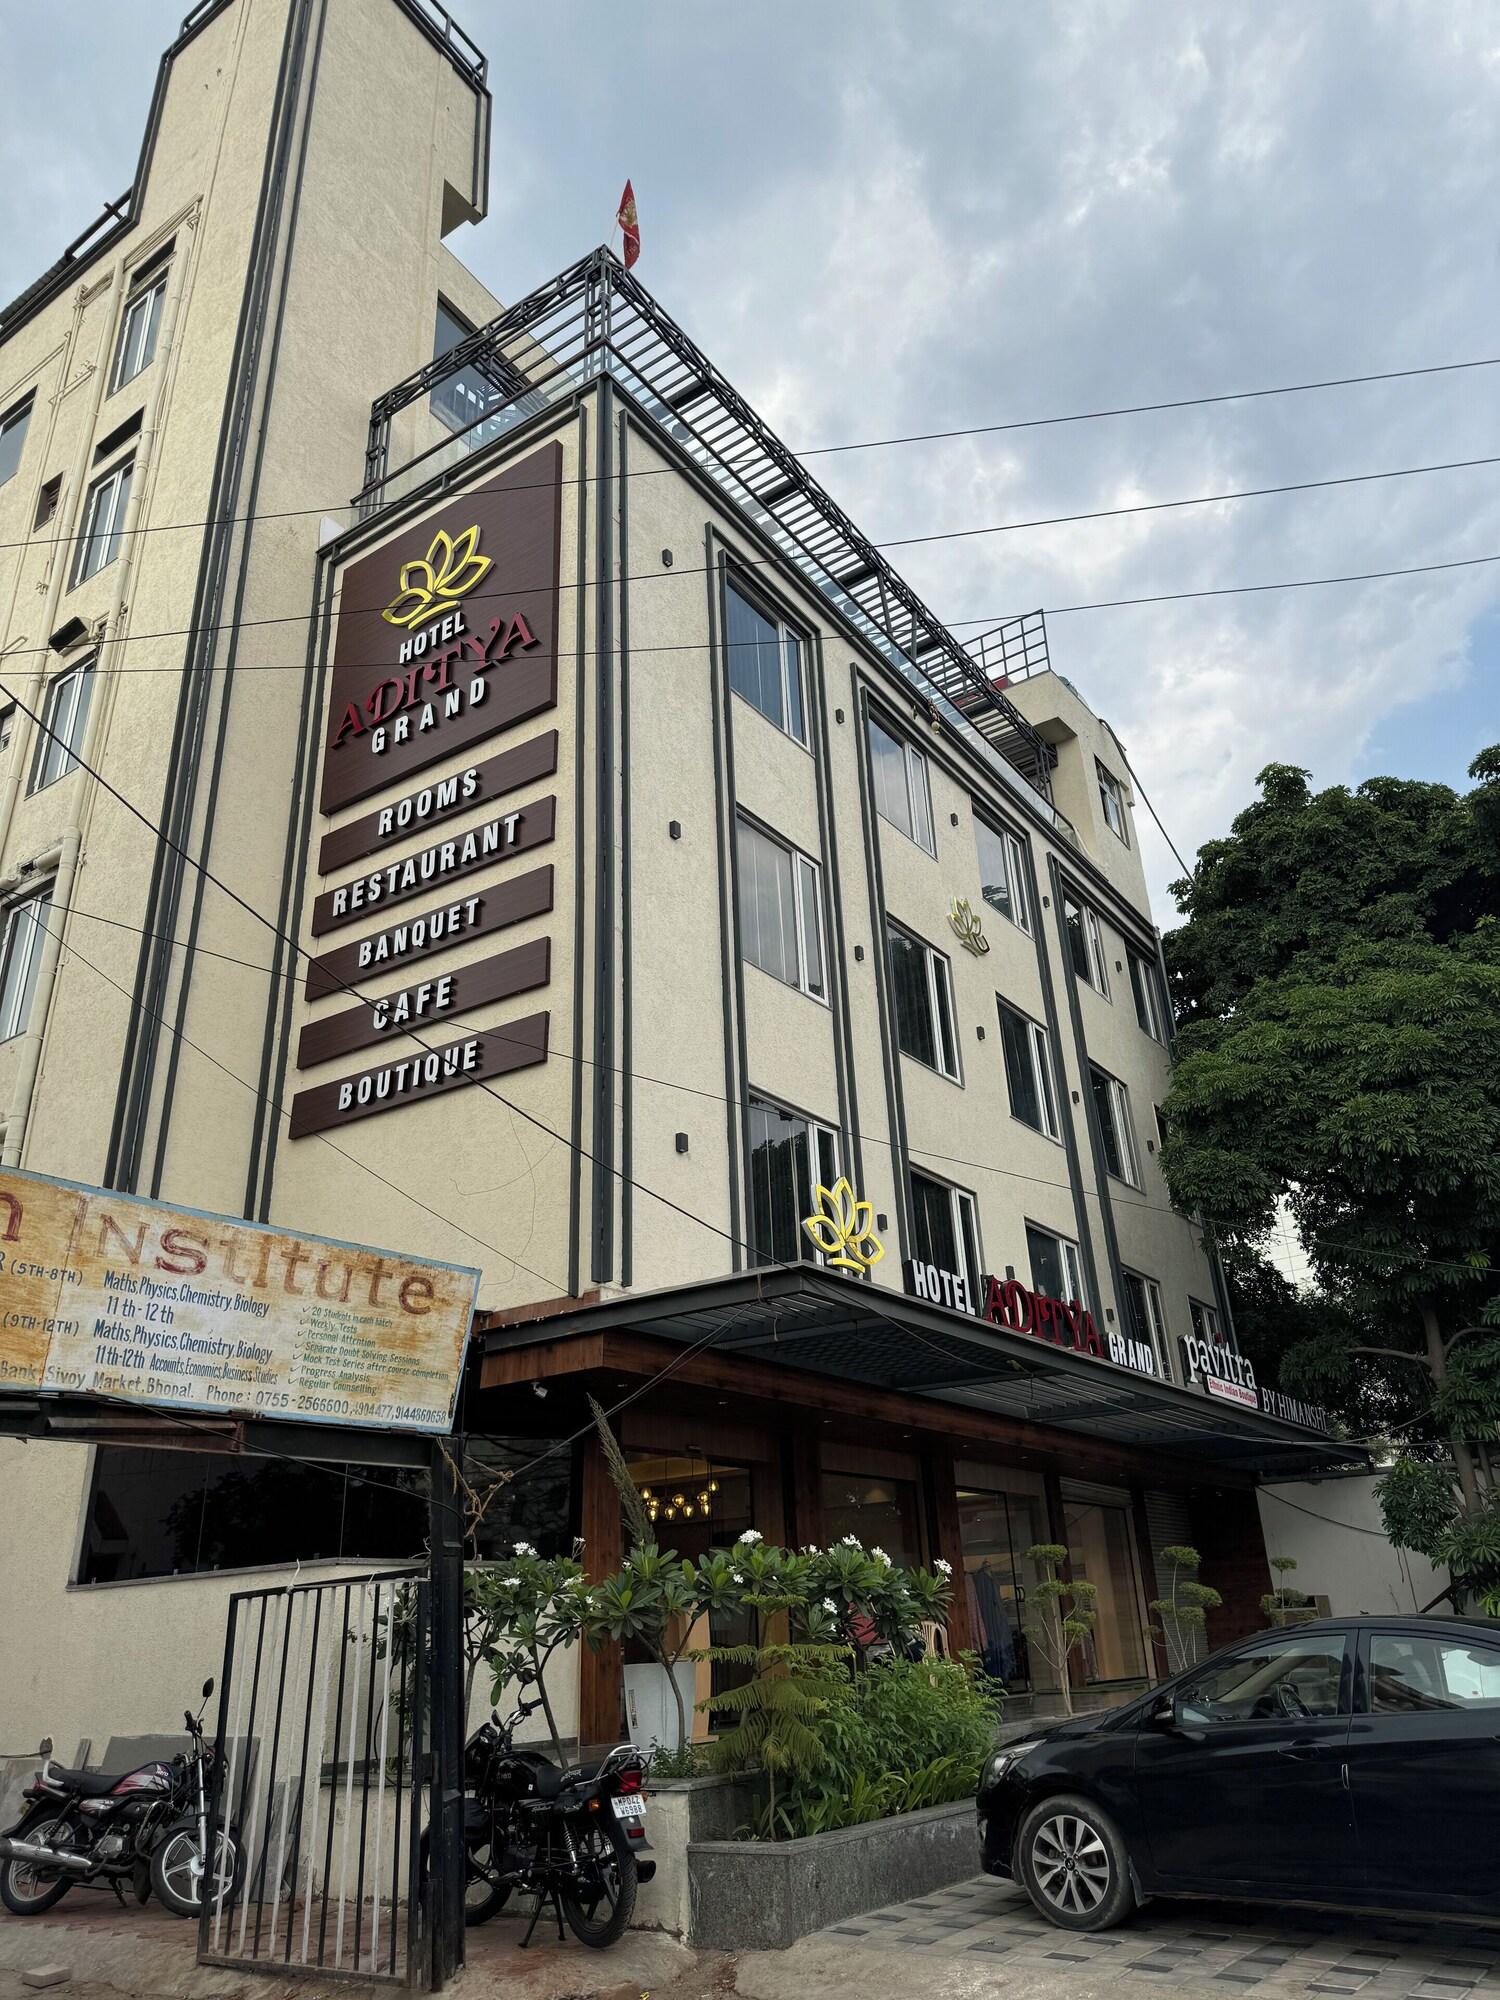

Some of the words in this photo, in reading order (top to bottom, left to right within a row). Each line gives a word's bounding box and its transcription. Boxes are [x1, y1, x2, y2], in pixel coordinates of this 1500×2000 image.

[399, 611, 466, 664] HOTEL
[332, 611, 538, 749] ADITYA
[371, 677, 485, 754] GRAND
[378, 768, 478, 836] ROOMS
[332, 813, 521, 917] RESTAURANT
[358, 897, 480, 968] BANQUET
[372, 975, 453, 1030] CAFE
[338, 1040, 478, 1111] BOUTIQUE
[912, 1258, 976, 1317] HOTEL
[983, 1274, 1105, 1359] ADITYA
[1107, 1331, 1155, 1376] GRAND
[1183, 1334, 1257, 1390] pavitra
[1261, 1387, 1275, 1415] BY
